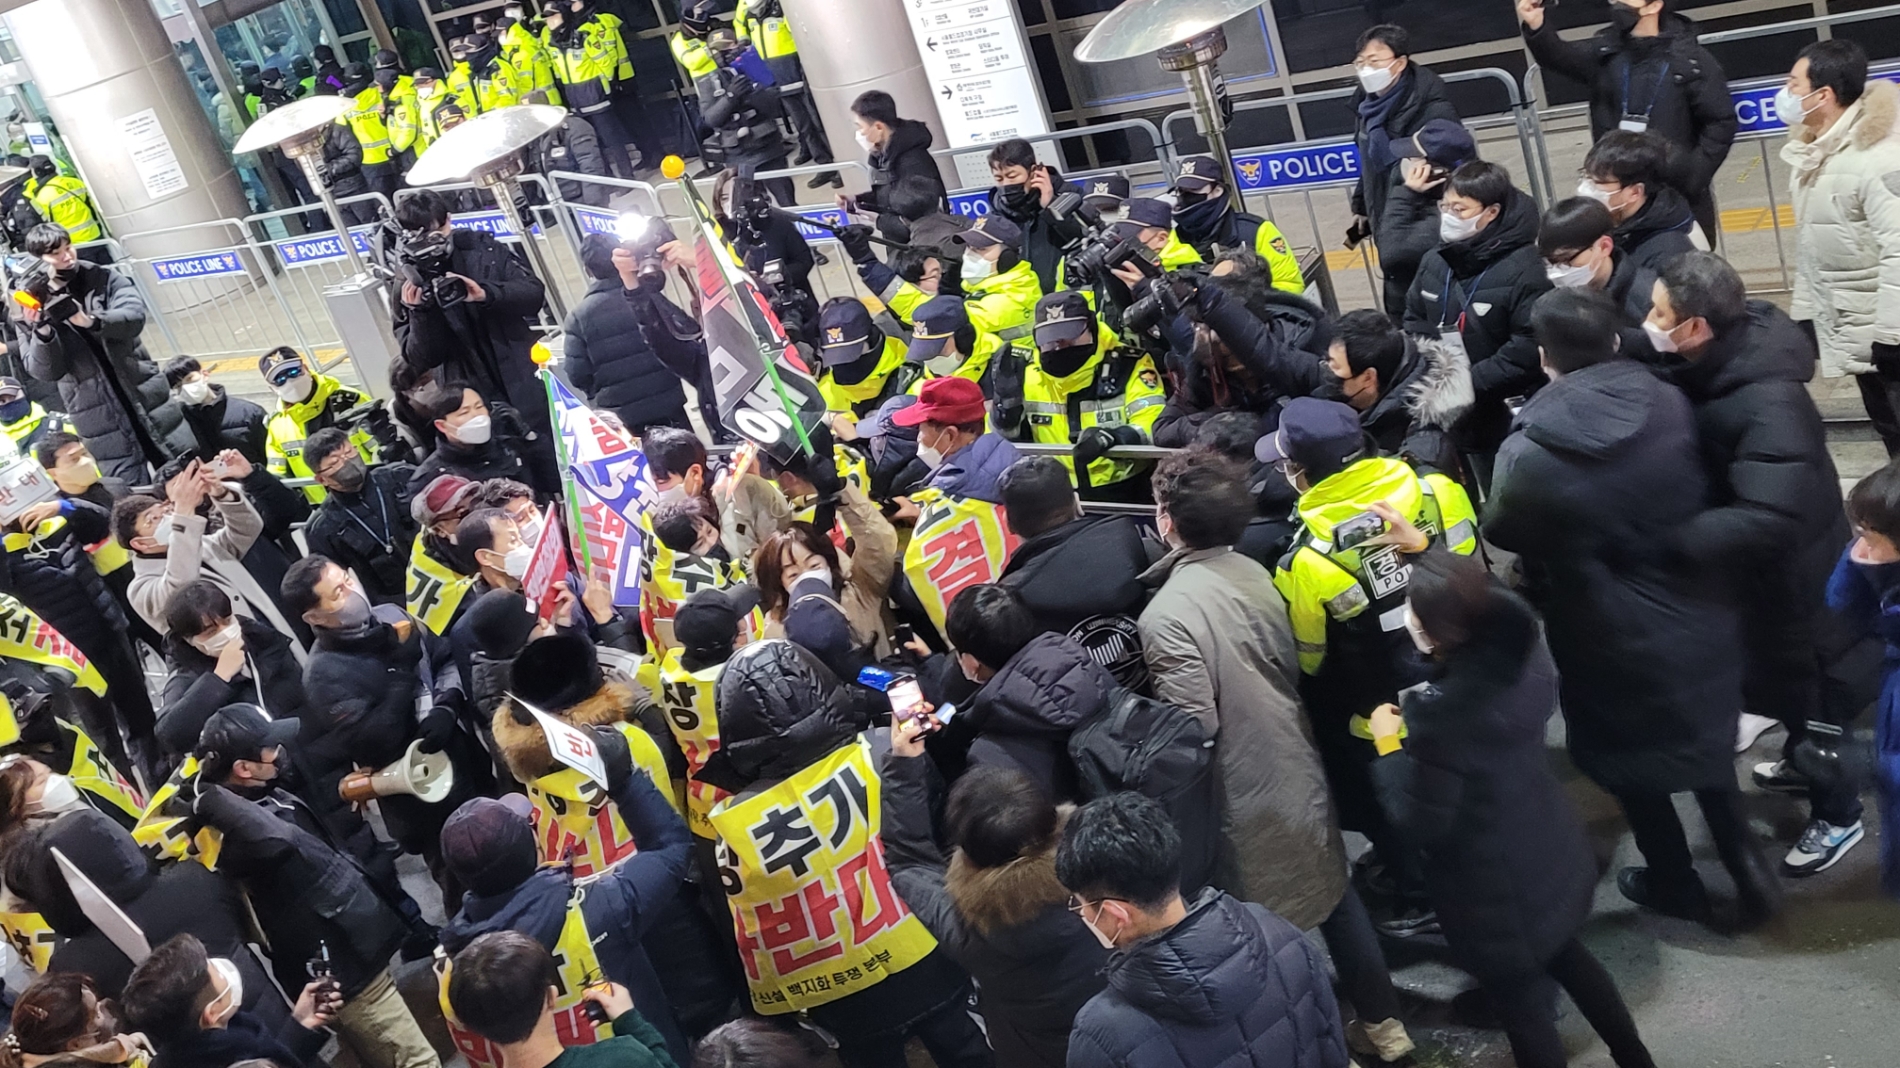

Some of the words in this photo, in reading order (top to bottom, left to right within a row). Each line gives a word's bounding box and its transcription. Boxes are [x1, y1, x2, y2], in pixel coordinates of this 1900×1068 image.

[1268, 151, 1358, 180] POLICE
[298, 239, 338, 259] POLICE
[167, 260, 203, 276] POLICE
[203, 257, 223, 273] LINE
[786, 974, 832, 997] 백지화
[832, 966, 864, 986] 투쟁
[862, 948, 894, 973] 본부
